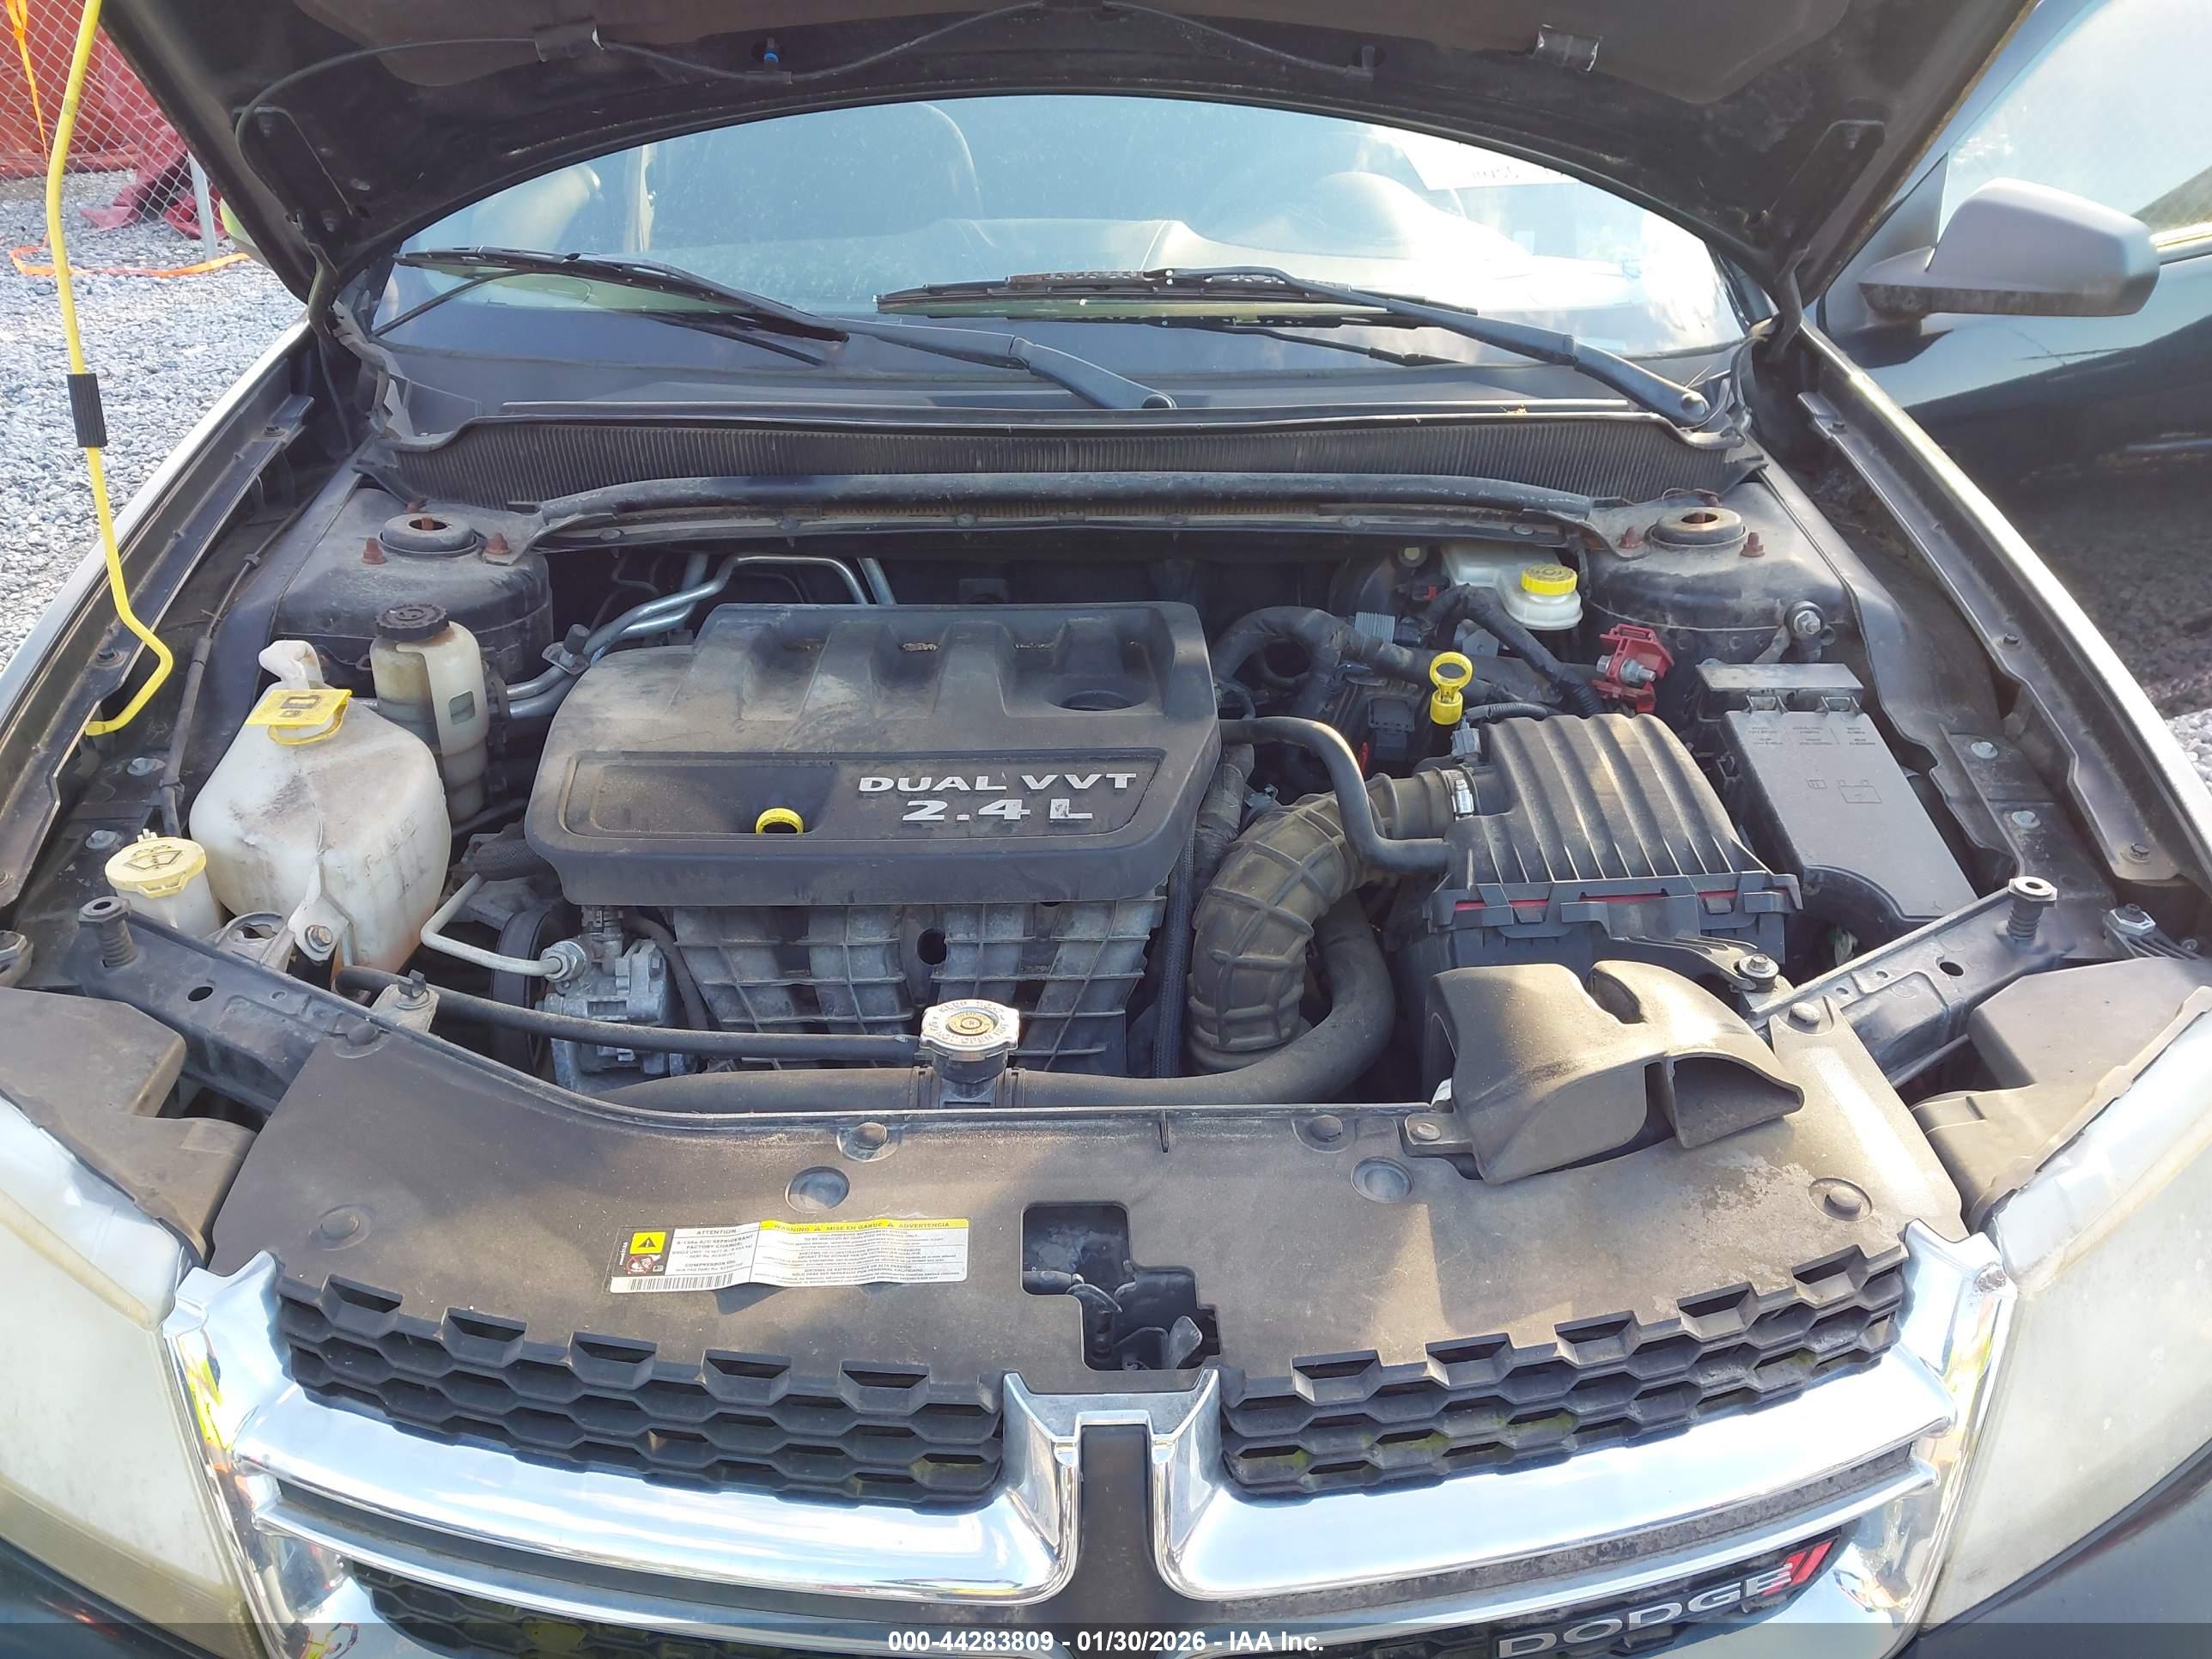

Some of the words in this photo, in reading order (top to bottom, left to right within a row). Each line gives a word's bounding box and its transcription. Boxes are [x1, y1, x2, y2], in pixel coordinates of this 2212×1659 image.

[858, 775, 1007, 792] DUAL
[1021, 773, 1137, 790] VVT
[774, 1224, 810, 1232] WARNING
[1498, 1562, 1793, 1658] DODGE
